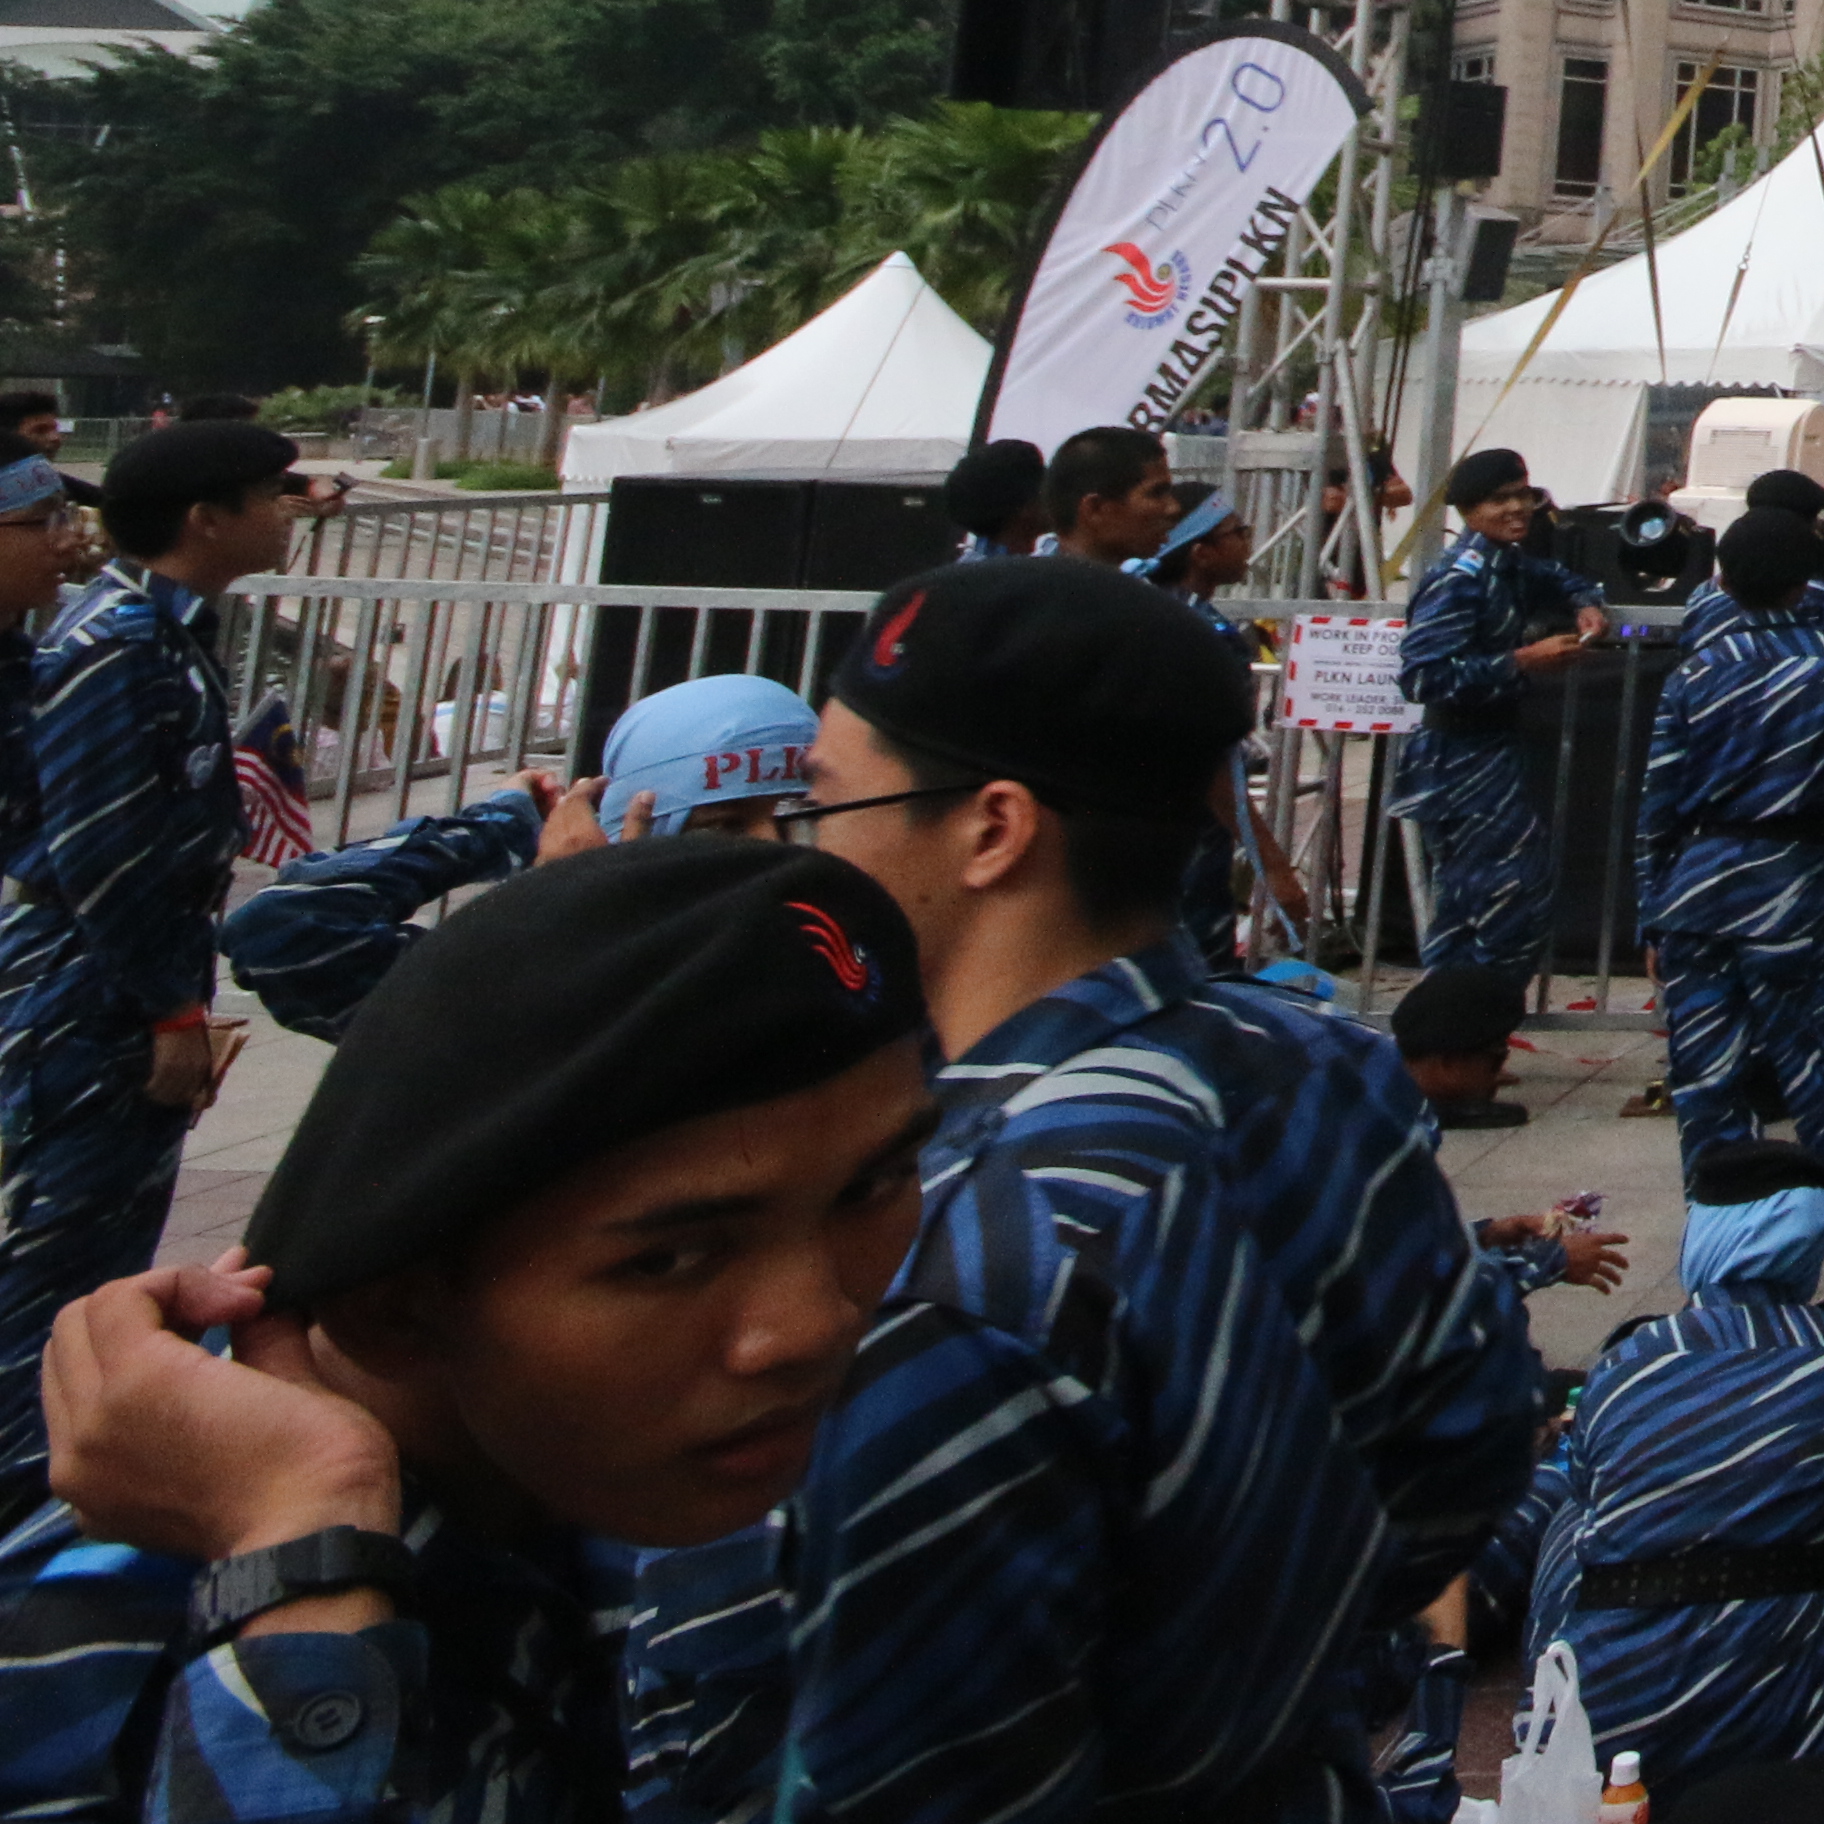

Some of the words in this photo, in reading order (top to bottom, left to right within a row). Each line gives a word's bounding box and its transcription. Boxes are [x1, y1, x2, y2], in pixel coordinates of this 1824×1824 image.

[1202, 62, 1286, 173] 2.0
[1310, 629, 1349, 640] WORK
[1355, 631, 1368, 641] IN
[1343, 644, 1373, 655] KEEP
[1314, 670, 1352, 683] PLKN
